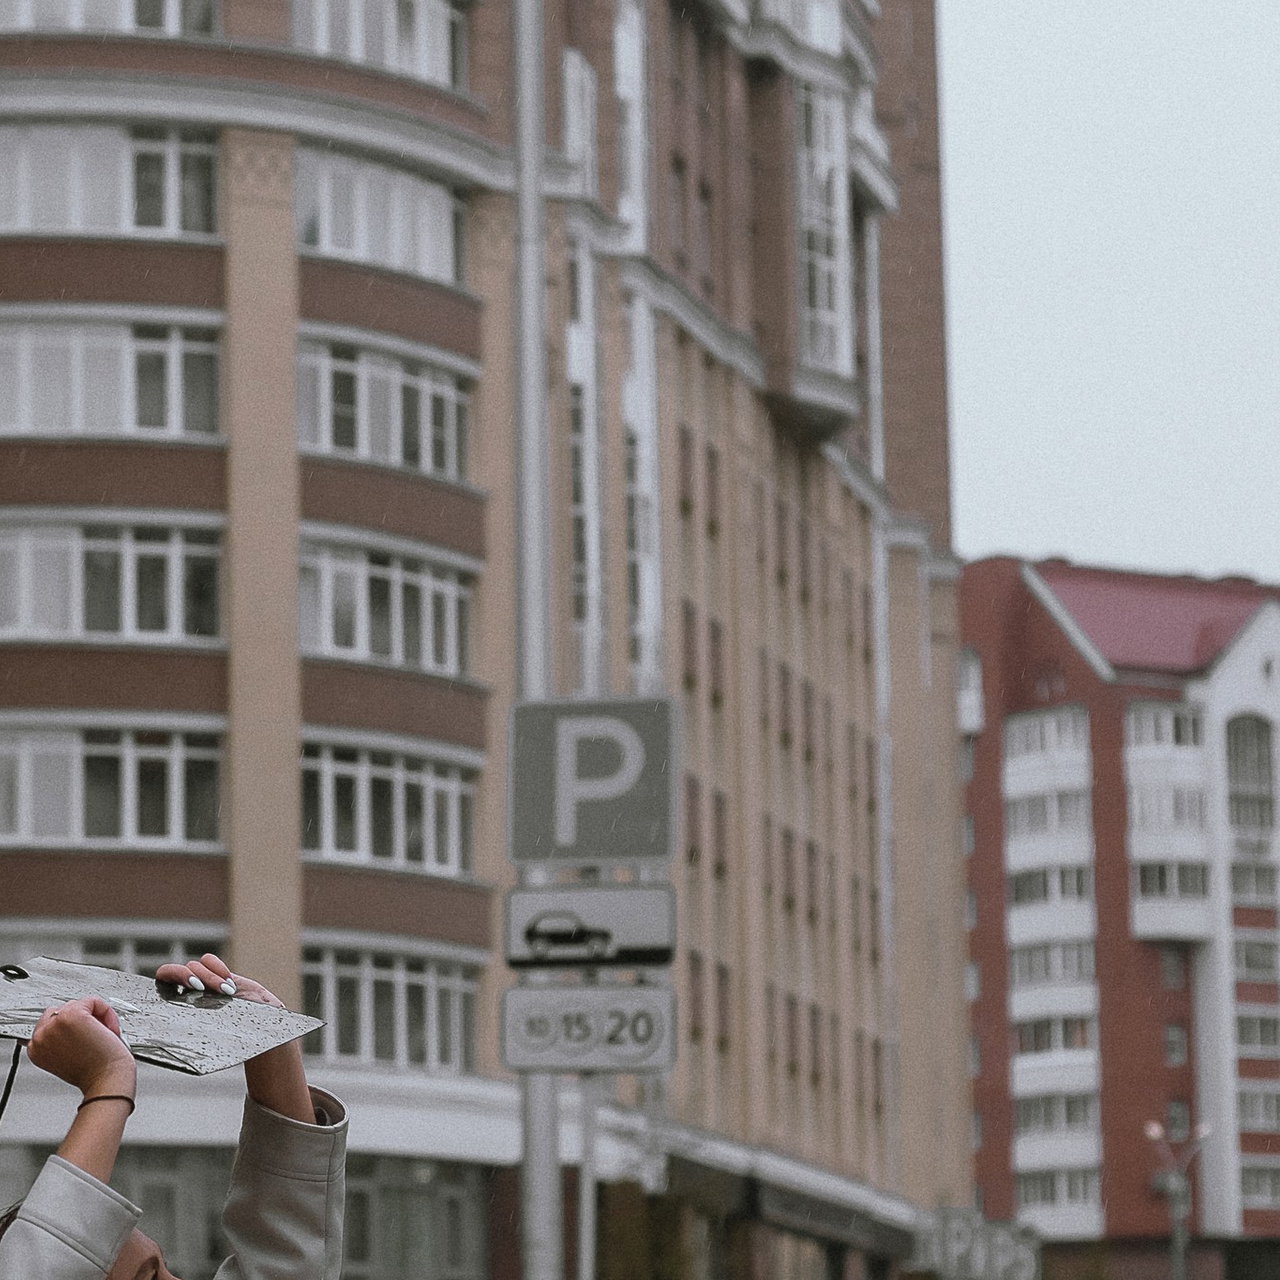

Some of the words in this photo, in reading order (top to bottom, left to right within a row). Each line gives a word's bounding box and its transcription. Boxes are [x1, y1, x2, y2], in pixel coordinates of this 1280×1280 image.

[555, 717, 647, 846] P
[562, 1011, 592, 1042] 15
[606, 1008, 654, 1045] 20
